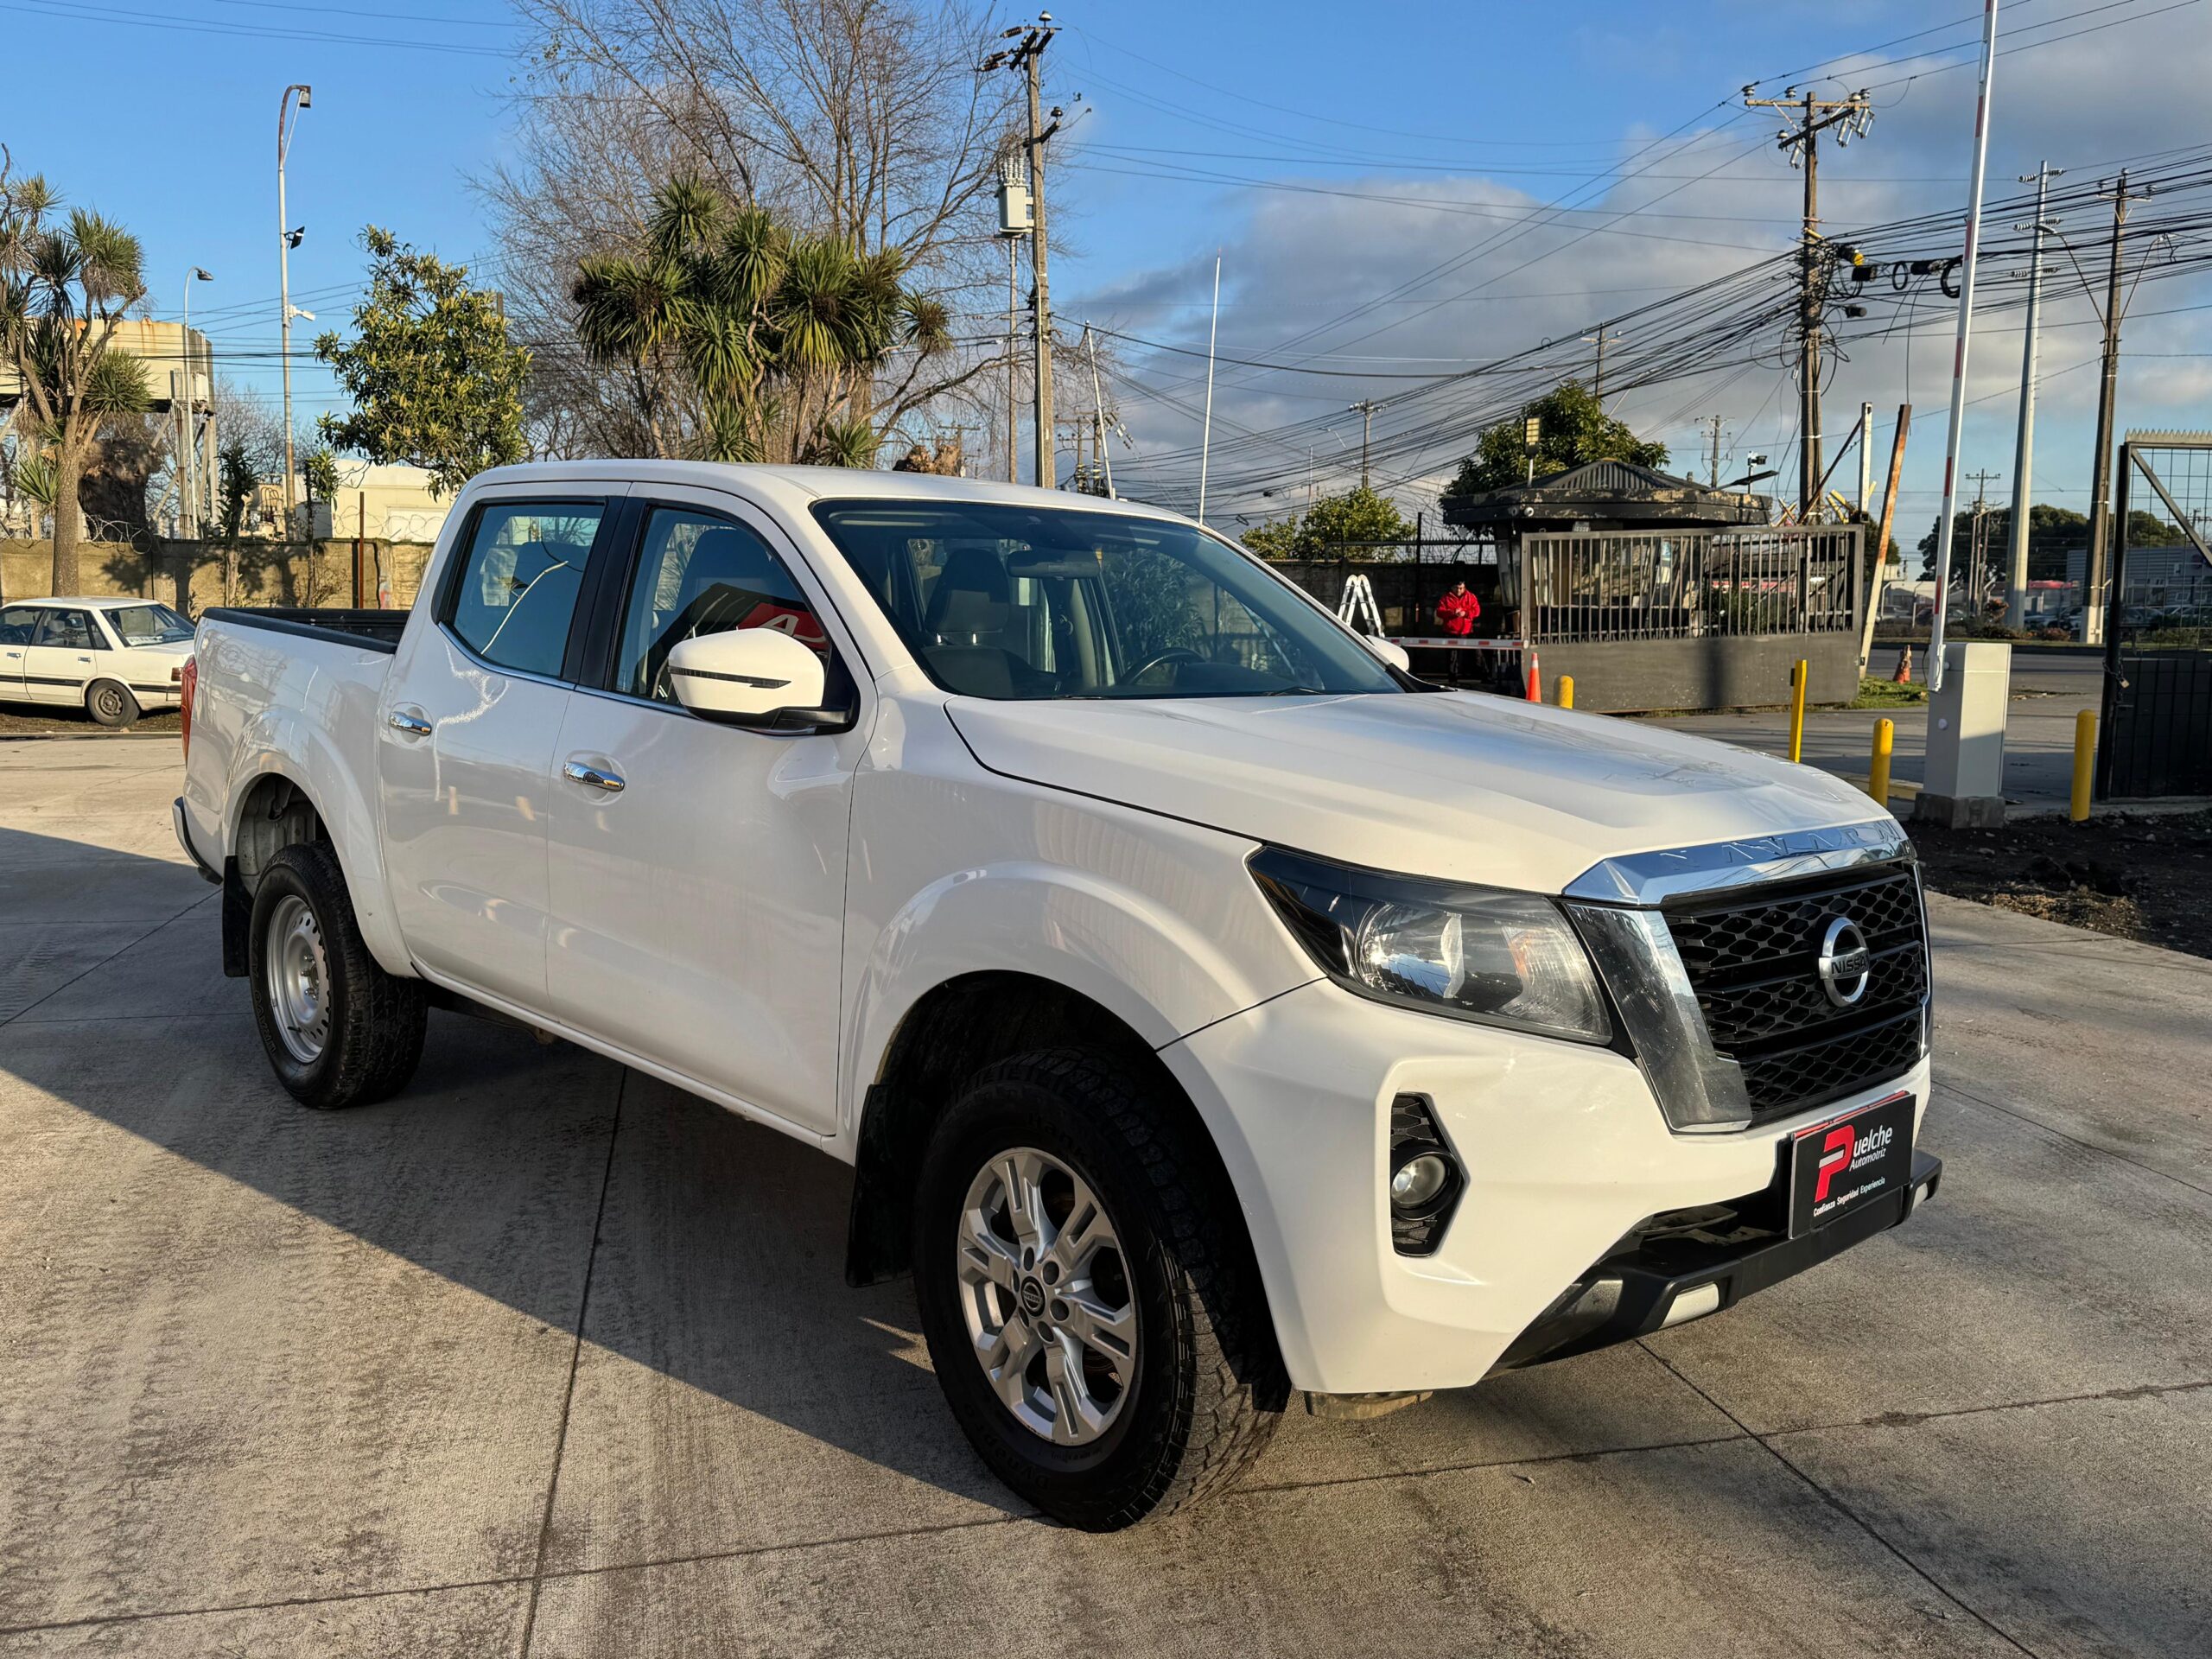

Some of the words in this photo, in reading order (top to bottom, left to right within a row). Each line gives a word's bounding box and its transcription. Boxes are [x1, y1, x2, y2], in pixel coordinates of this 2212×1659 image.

[1028, 1112, 1120, 1218] Hankoo
[1848, 1147, 1887, 1172] Automotriz
[1813, 1201, 1836, 1217] Confianza
[1836, 1187, 1859, 1205] Seguridad
[1859, 1176, 1885, 1193] Experiencia
